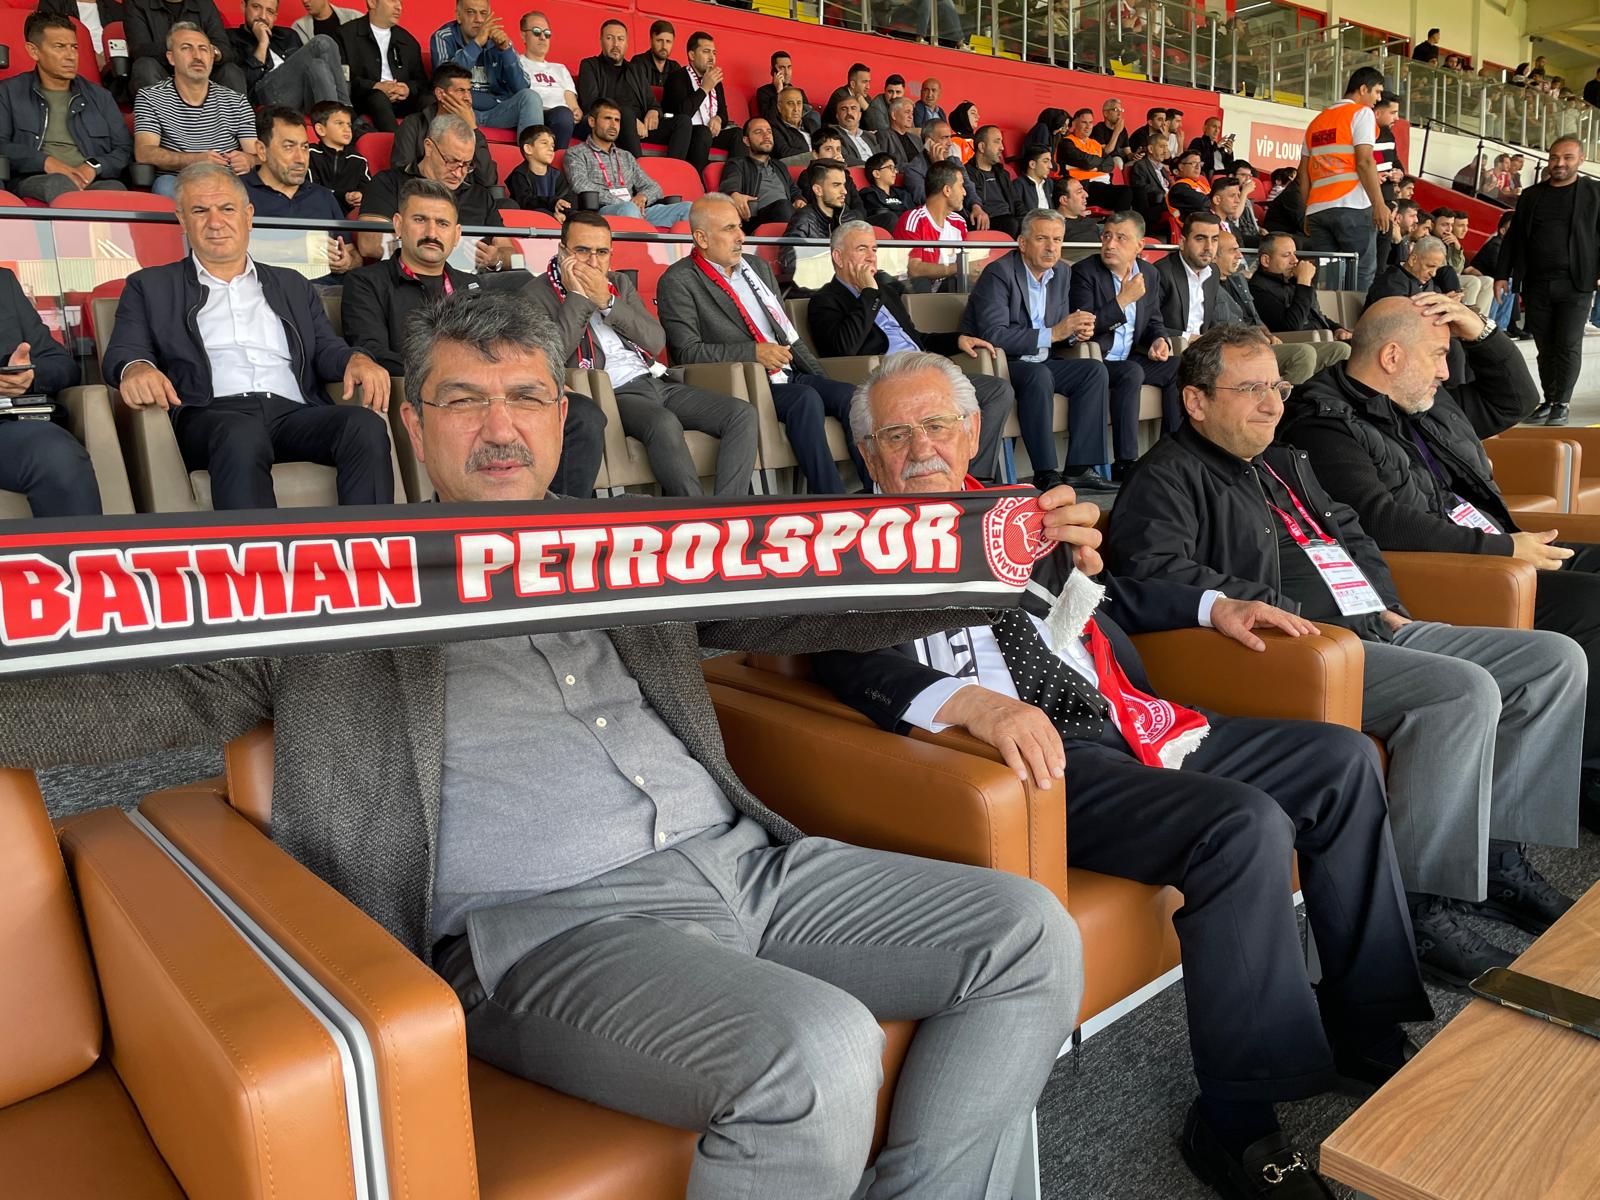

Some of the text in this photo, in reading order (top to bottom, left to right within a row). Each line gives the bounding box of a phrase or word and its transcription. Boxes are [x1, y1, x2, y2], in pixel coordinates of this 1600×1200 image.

[1275, 141, 1303, 160] LOUN
[0, 502, 965, 646] BATMAN PETROLSPOR
